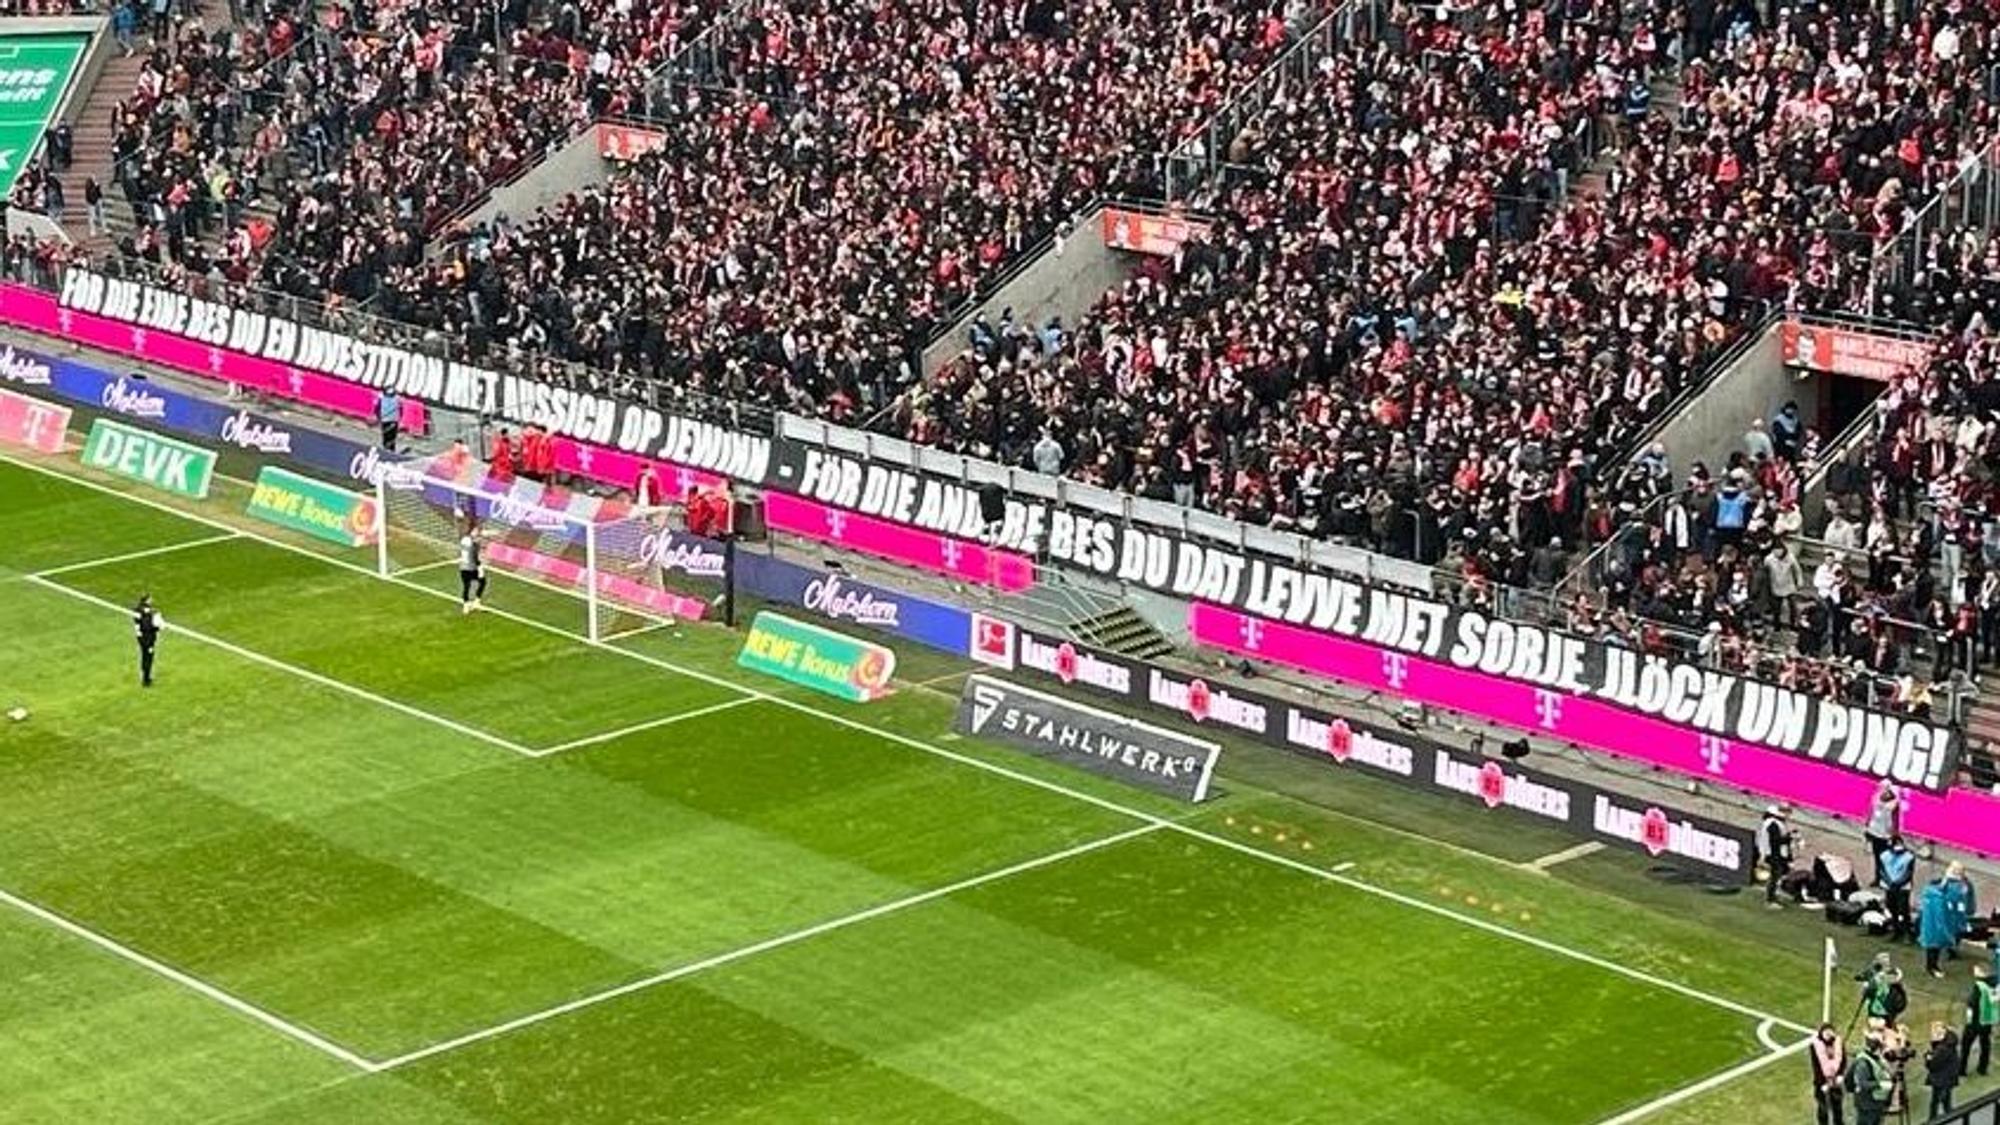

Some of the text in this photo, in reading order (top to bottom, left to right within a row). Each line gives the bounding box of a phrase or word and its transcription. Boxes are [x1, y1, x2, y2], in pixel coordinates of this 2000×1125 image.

[92, 427, 195, 491] DEVK
[250, 482, 303, 517] REWE
[60, 267, 104, 312] FÖR
[101, 278, 142, 324] DIE
[137, 286, 189, 335] EINE
[186, 297, 231, 346] BES
[228, 309, 266, 355] DU
[261, 318, 298, 363] EN
[295, 325, 444, 403] INVESTITION
[443, 361, 500, 414] MET
[502, 375, 617, 443] AUSSICH
[618, 405, 663, 452] OP
[657, 415, 771, 484] JEWINN
[799, 449, 863, 505] FÖR
[857, 464, 918, 523] DIE
[1048, 509, 1116, 573] BES
[1116, 528, 1171, 587] DU
[1172, 541, 1246, 606] DAT
[1245, 558, 1362, 636] LEVVE
[1361, 589, 1448, 656] MET
[1596, 646, 1736, 734] JLÖCK
[1736, 680, 1809, 751] UN
[1809, 702, 1951, 791] PING!
[747, 629, 850, 681] REWE Bonus
